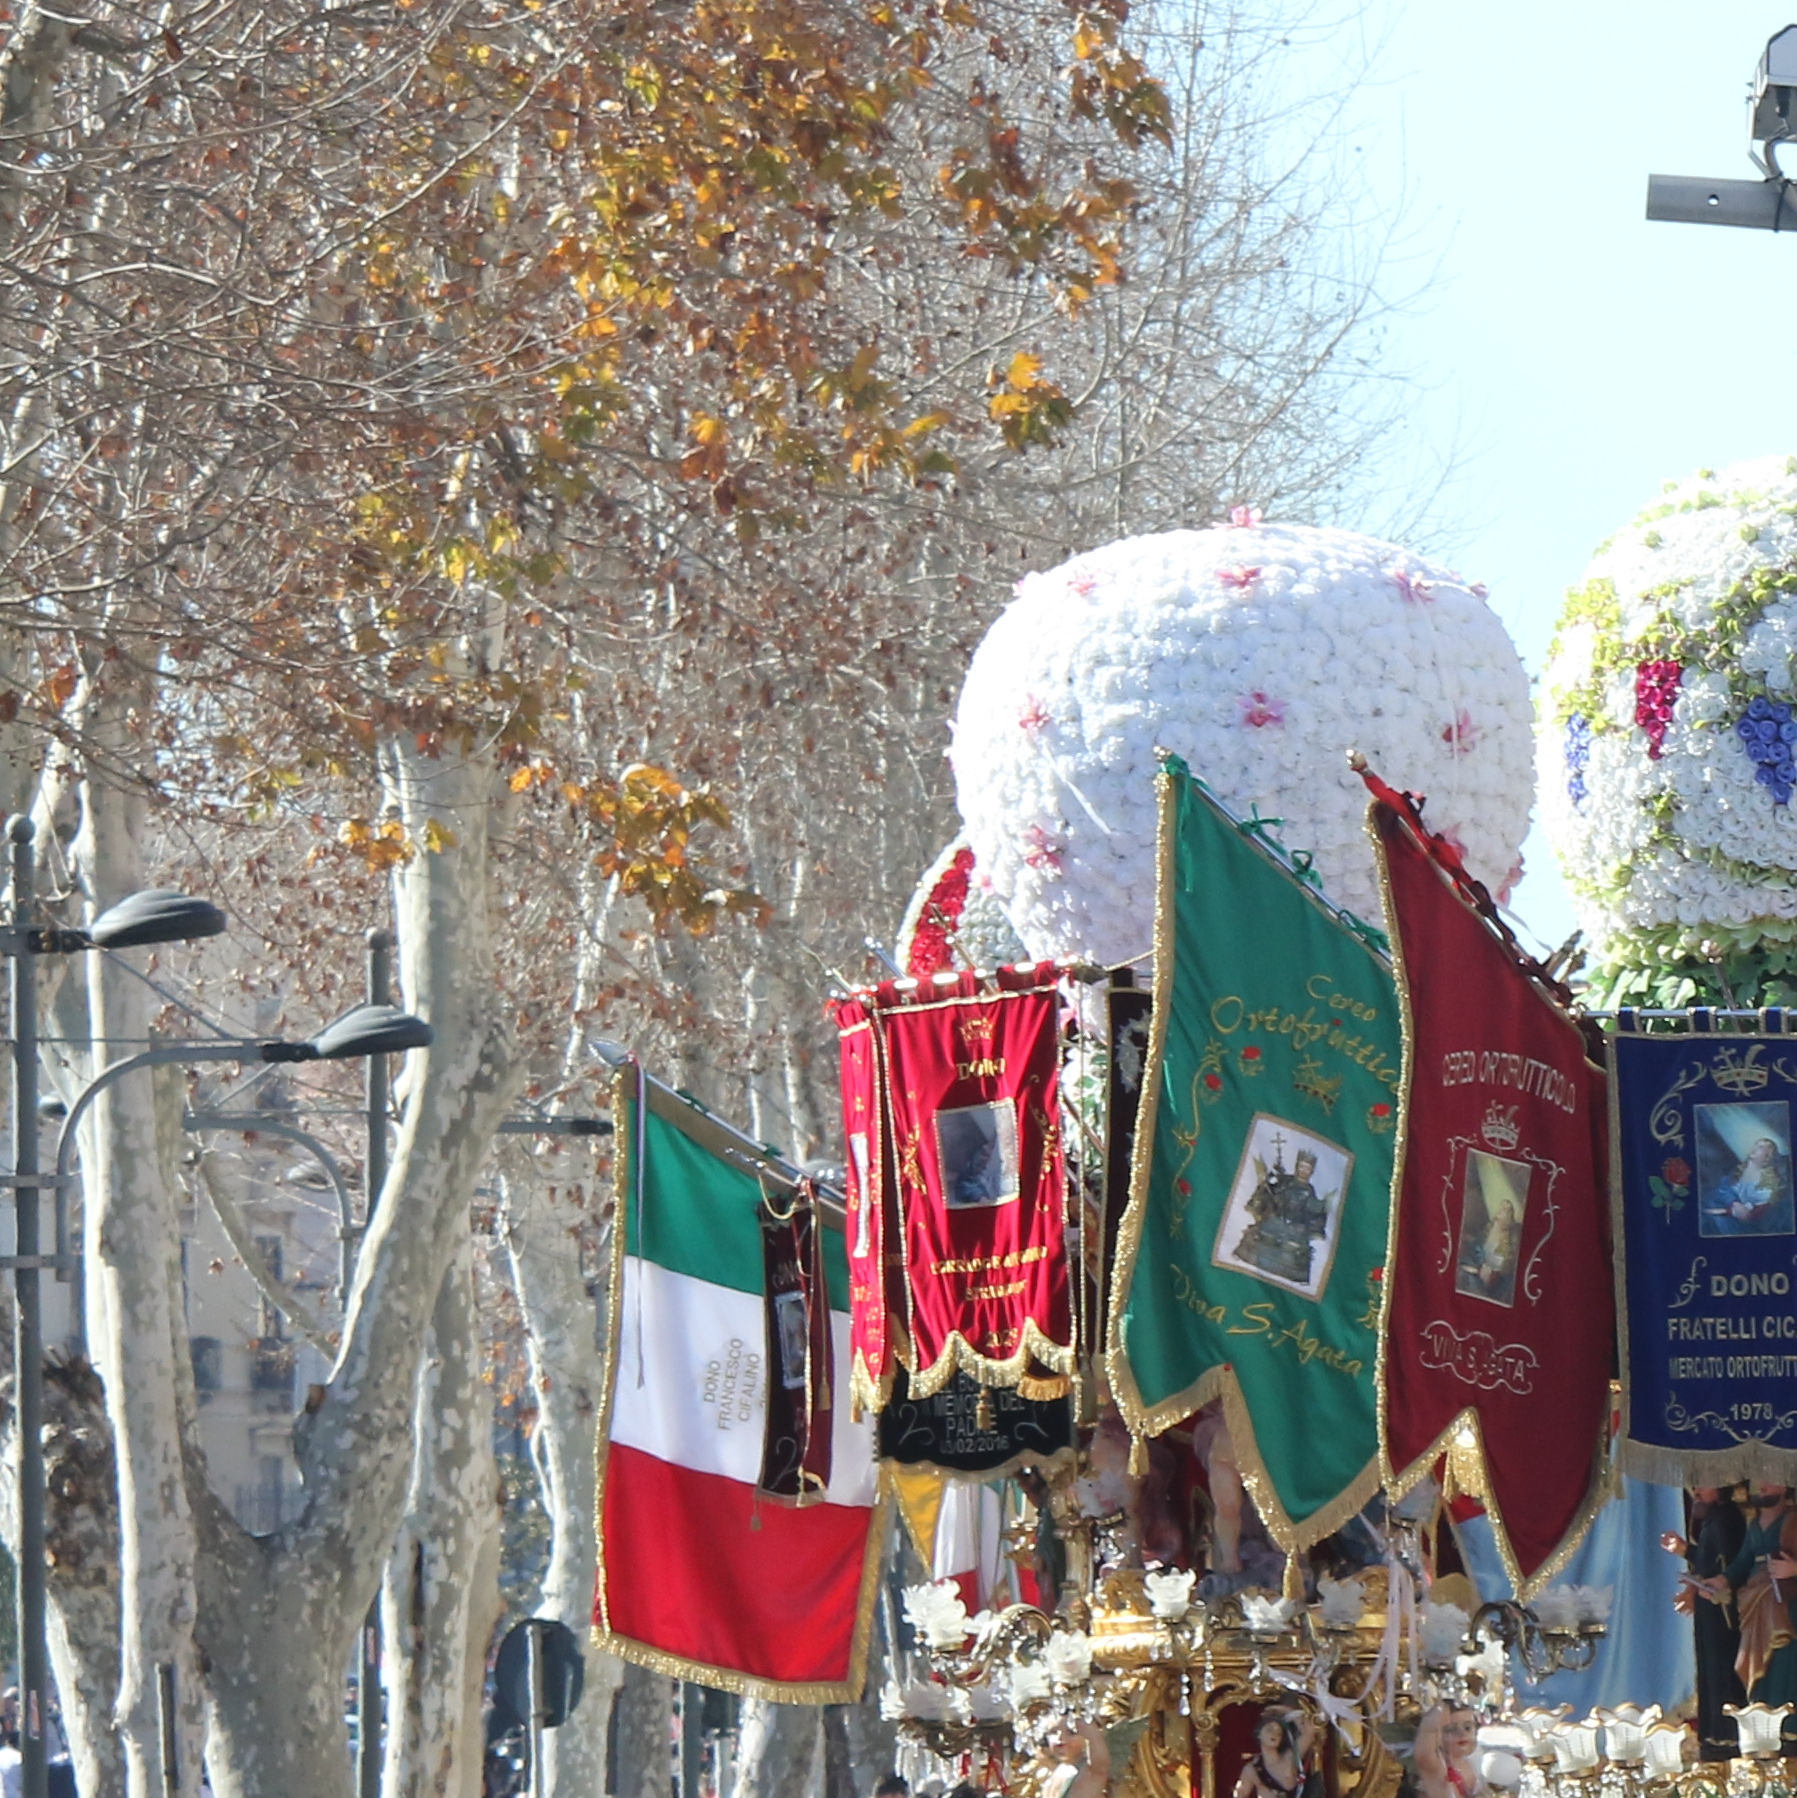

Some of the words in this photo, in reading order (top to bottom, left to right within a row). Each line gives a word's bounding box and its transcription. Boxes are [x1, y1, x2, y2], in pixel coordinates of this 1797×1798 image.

[1307, 975, 1377, 1021] Cereo
[1442, 1050, 1476, 1087] CEREO
[1710, 1273, 1790, 1297] DONO
[1668, 1317, 1757, 1341] FRATELLI
[703, 1360, 721, 1403] DONO
[718, 1338, 744, 1431] FRANCESCO
[1669, 1356, 1724, 1379] MERCATO
[738, 1353, 761, 1422] CIFALINO
[1730, 1402, 1774, 1421] 1978
